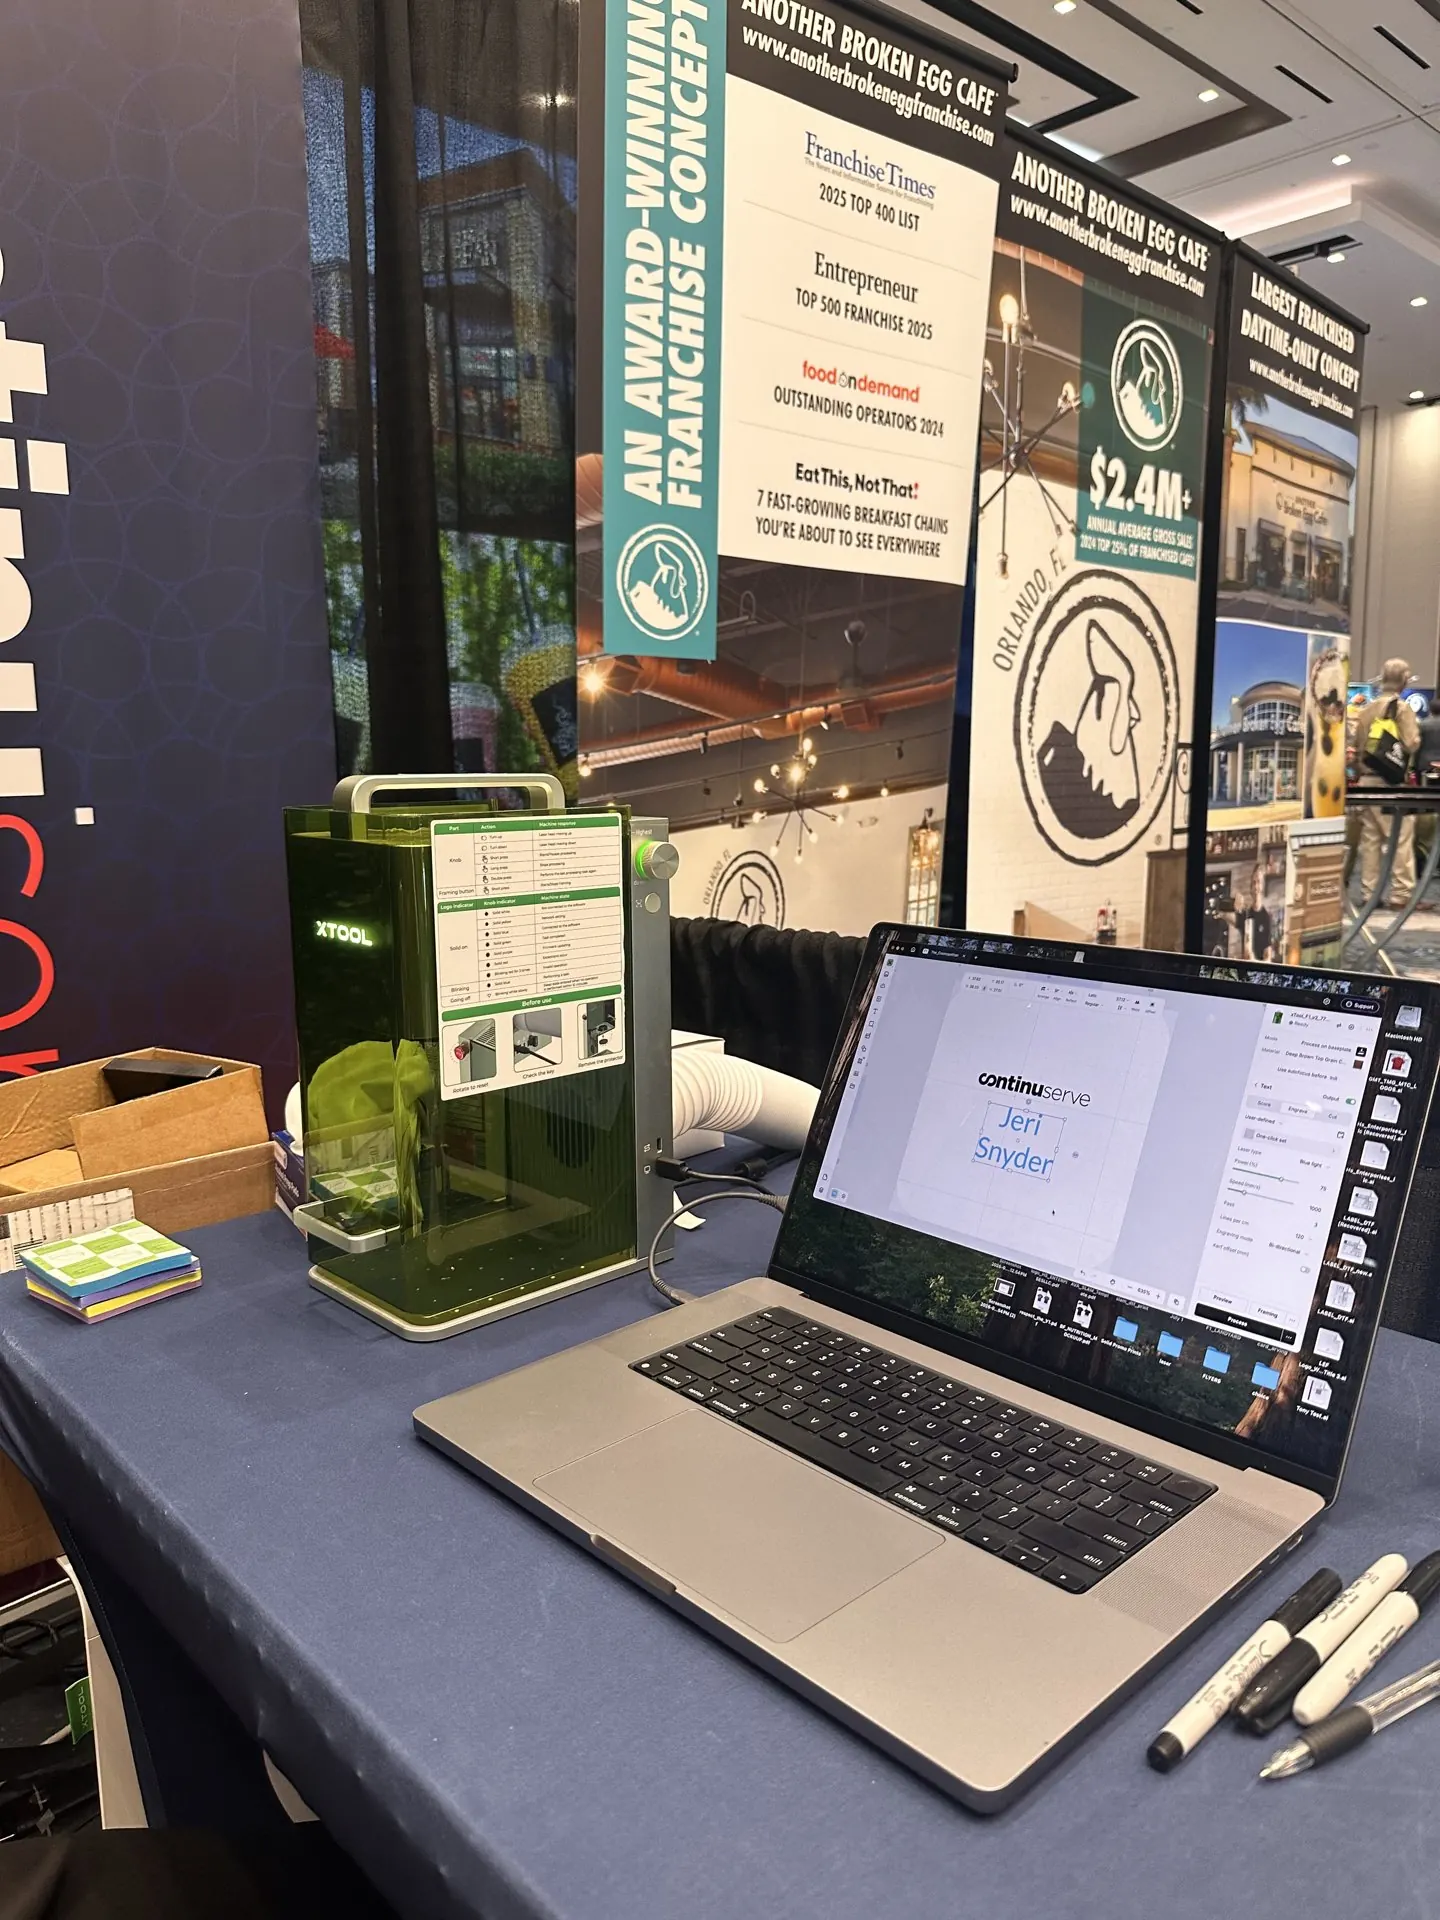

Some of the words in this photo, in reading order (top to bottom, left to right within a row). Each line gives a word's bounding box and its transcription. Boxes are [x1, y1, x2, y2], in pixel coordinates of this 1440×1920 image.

[741, 0, 836, 48] ANOTHER
[840, 24, 914, 81] BROKEN
[916, 59, 953, 97] EGG
[742, 25, 995, 147] www.anotherbrokeneggfranchise.com
[624, 0, 667, 418] AWARD-WINNIN
[819, 182, 847, 207] 2025
[850, 193, 872, 215] TOP
[875, 202, 895, 224] 400
[898, 209, 920, 231] LIST
[1011, 151, 1085, 217] ANOTHER
[1088, 191, 1145, 243] BROKEN
[1147, 218, 1176, 256] EGG
[1010, 193, 1205, 298] www.anotherbrokeneggfranchise.com
[814, 251, 919, 303] Entrepreneur
[795, 287, 817, 308] TOP
[820, 293, 841, 317] 500
[844, 301, 905, 334] FRANCHISE
[906, 316, 933, 340] 2025
[1250, 271, 1297, 323] LARGEST
[1297, 294, 1356, 354] FRANCHISED
[1240, 308, 1319, 372] DAYTIME-ONLY
[1320, 346, 1360, 393] CONCEPT
[667, 237, 706, 509] FRANCHISE
[773, 385, 853, 420] OUTSTANDING
[856, 404, 917, 432] OPERATORS
[919, 418, 944, 438] 2024
[624, 430, 663, 506] AN
[795, 462, 819, 483] Eat
[820, 466, 853, 493] This,
[855, 473, 880, 494] Not
[757, 489, 763, 507] 7
[767, 491, 851, 521] FAST-GROWING
[854, 505, 912, 531] BREAKFAST
[914, 514, 949, 535] CHAINS
[756, 516, 796, 540] YOU'RE
[798, 520, 836, 545] ABOUT
[838, 528, 854, 546] TO
[855, 531, 874, 550] SEE
[876, 532, 941, 558] EVERYWHERE
[1087, 514, 1117, 535] ANNUAL
[1118, 521, 1152, 541] AVERAGE
[1153, 526, 1176, 546] GROSS
[1050, 546, 1067, 577] FL
[1080, 534, 1097, 550] 2024
[1097, 537, 1111, 552] TOP
[1128, 543, 1139, 557] OF
[1139, 545, 1178, 564] FRANCHISED
[315, 920, 373, 947] XTOOL
[522, 999, 540, 1007] Before
[541, 997, 552, 1005] use
[1353, 1002, 1375, 1011] Support
[1385, 1032, 1412, 1042] Macintosh
[1413, 1035, 1423, 1043] HD
[522, 1072, 537, 1080] Check
[546, 1069, 555, 1077] key
[578, 1060, 596, 1068] Remove
[604, 1055, 624, 1065] protector
[452, 1084, 470, 1094] Rotate
[978, 1071, 1091, 1107] continuserve
[1260, 1083, 1273, 1091] Text
[998, 1106, 1044, 1136] Jeri
[974, 1136, 1054, 1175] Snyder
[893, 1492, 927, 1510] command
[936, 1513, 960, 1527] option
[1149, 1500, 1173, 1513] delete
[1102, 1533, 1128, 1547] return
[1083, 1553, 1103, 1566] shift
